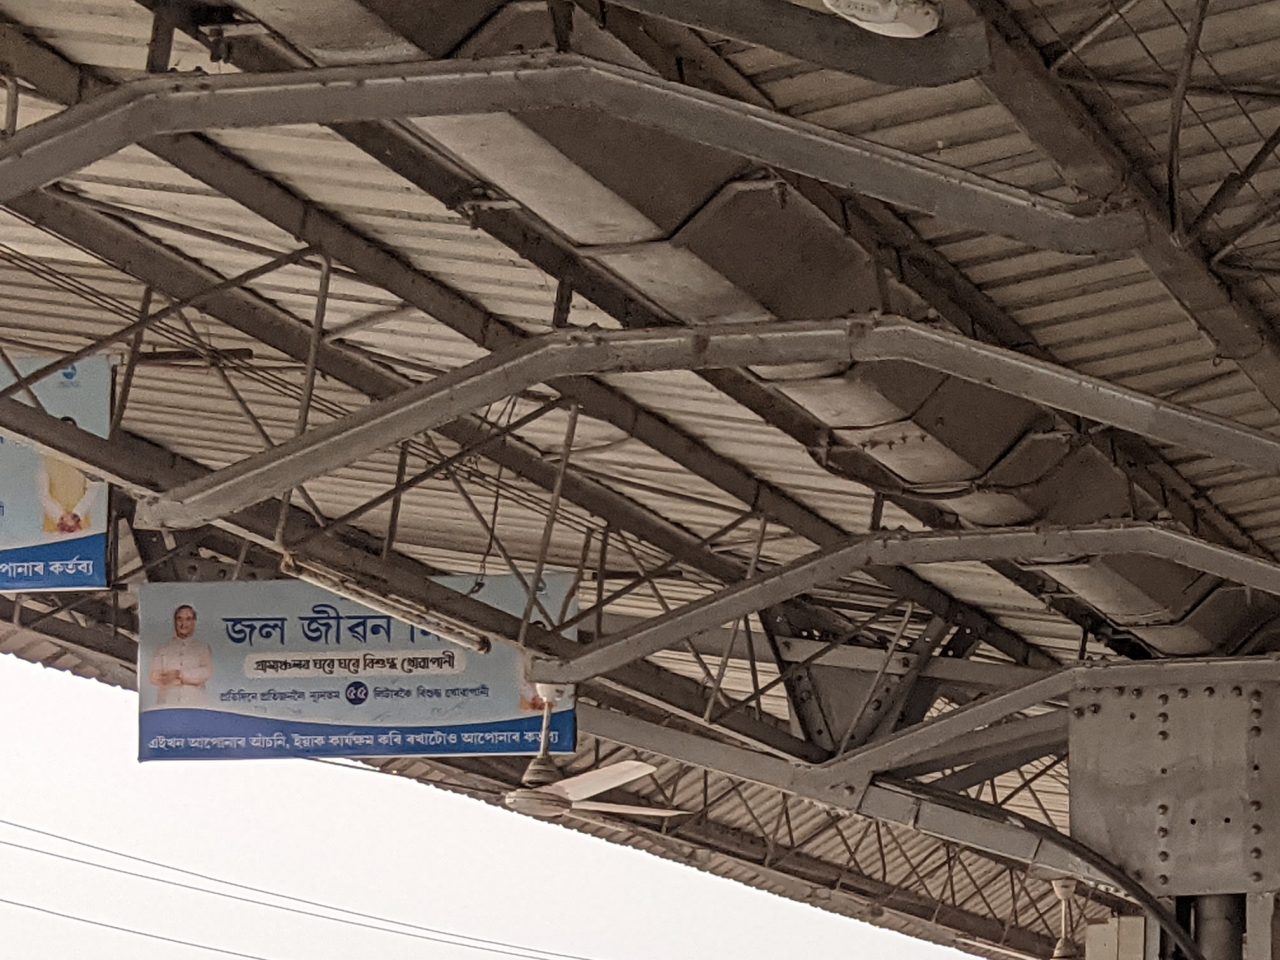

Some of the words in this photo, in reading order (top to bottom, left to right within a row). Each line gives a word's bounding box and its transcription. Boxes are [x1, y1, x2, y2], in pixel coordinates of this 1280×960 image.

[222, 617, 287, 646] জল
[298, 603, 394, 645] জীৱন
[347, 686, 367, 700] ৫৫
